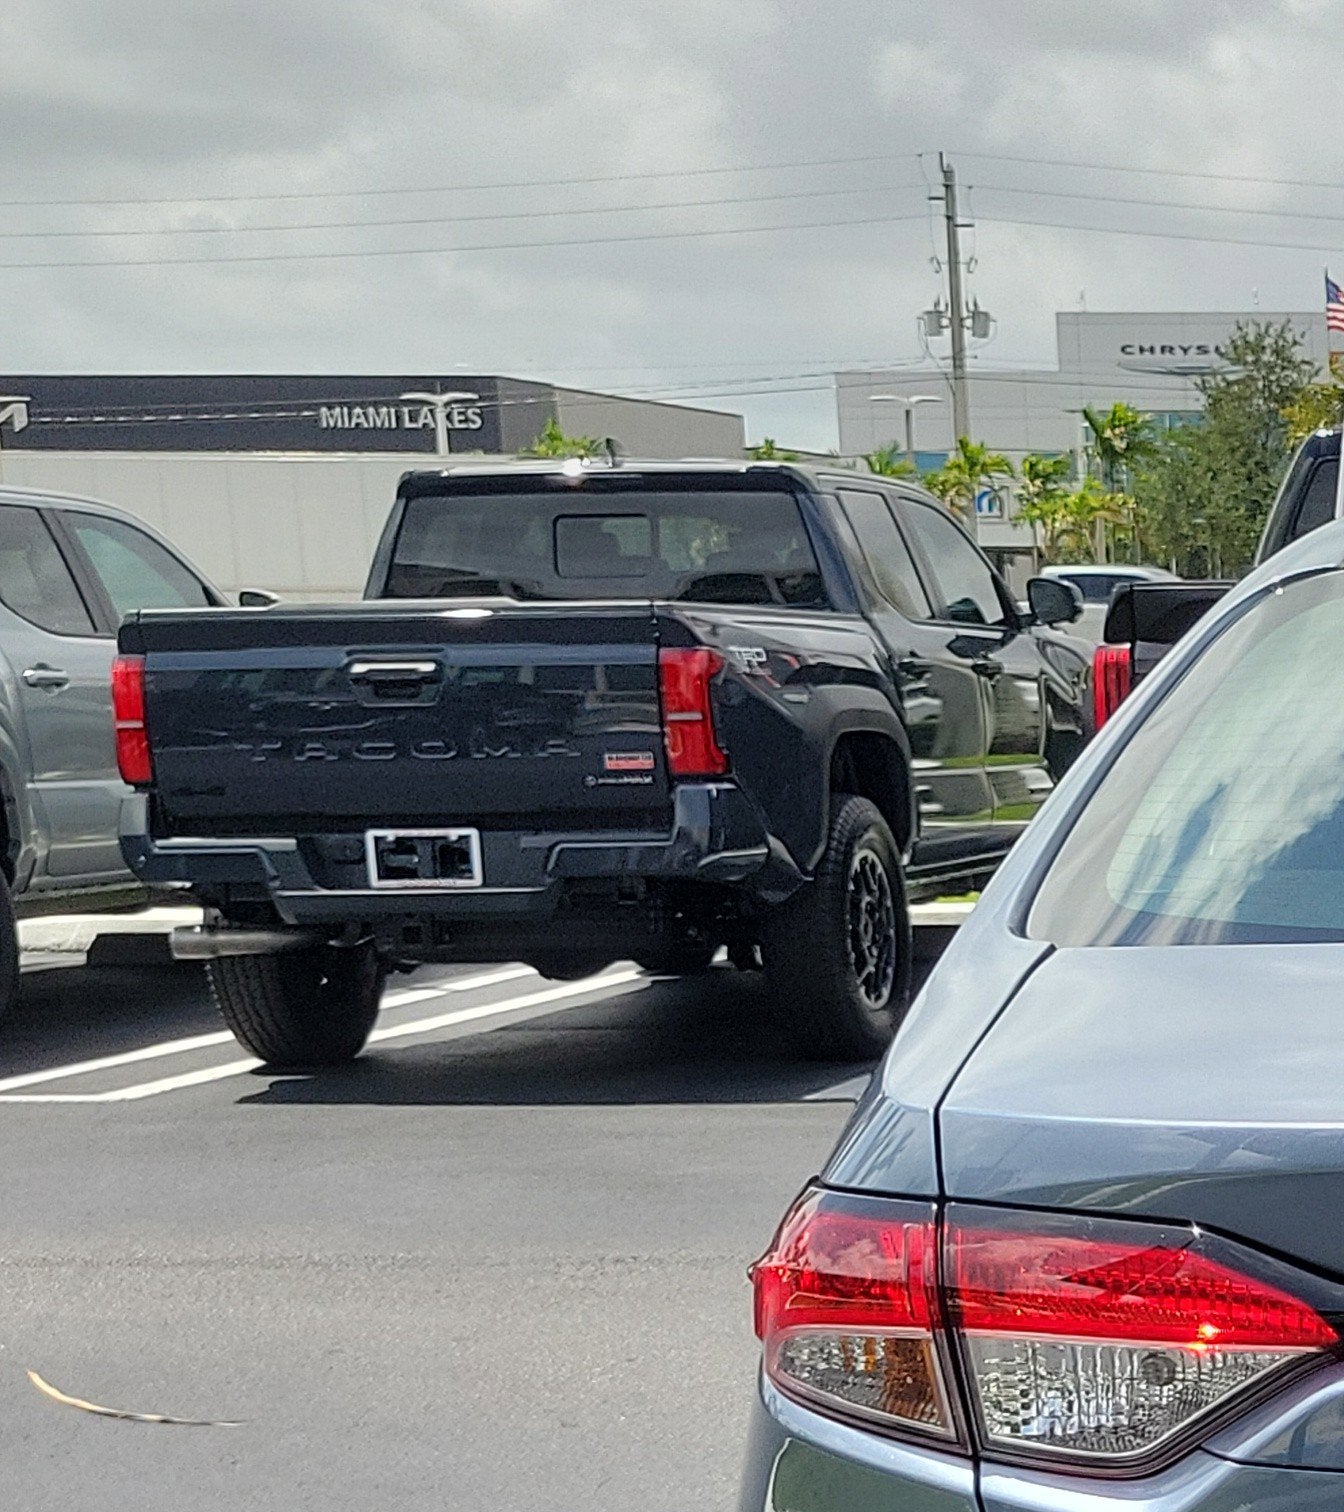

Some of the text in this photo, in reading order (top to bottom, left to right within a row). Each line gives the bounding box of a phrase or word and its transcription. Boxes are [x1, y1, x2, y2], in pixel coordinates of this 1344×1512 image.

[1120, 344, 1227, 358] CHRYSL
[319, 406, 397, 429] MIAMI
[234, 740, 582, 762] TACOMA
